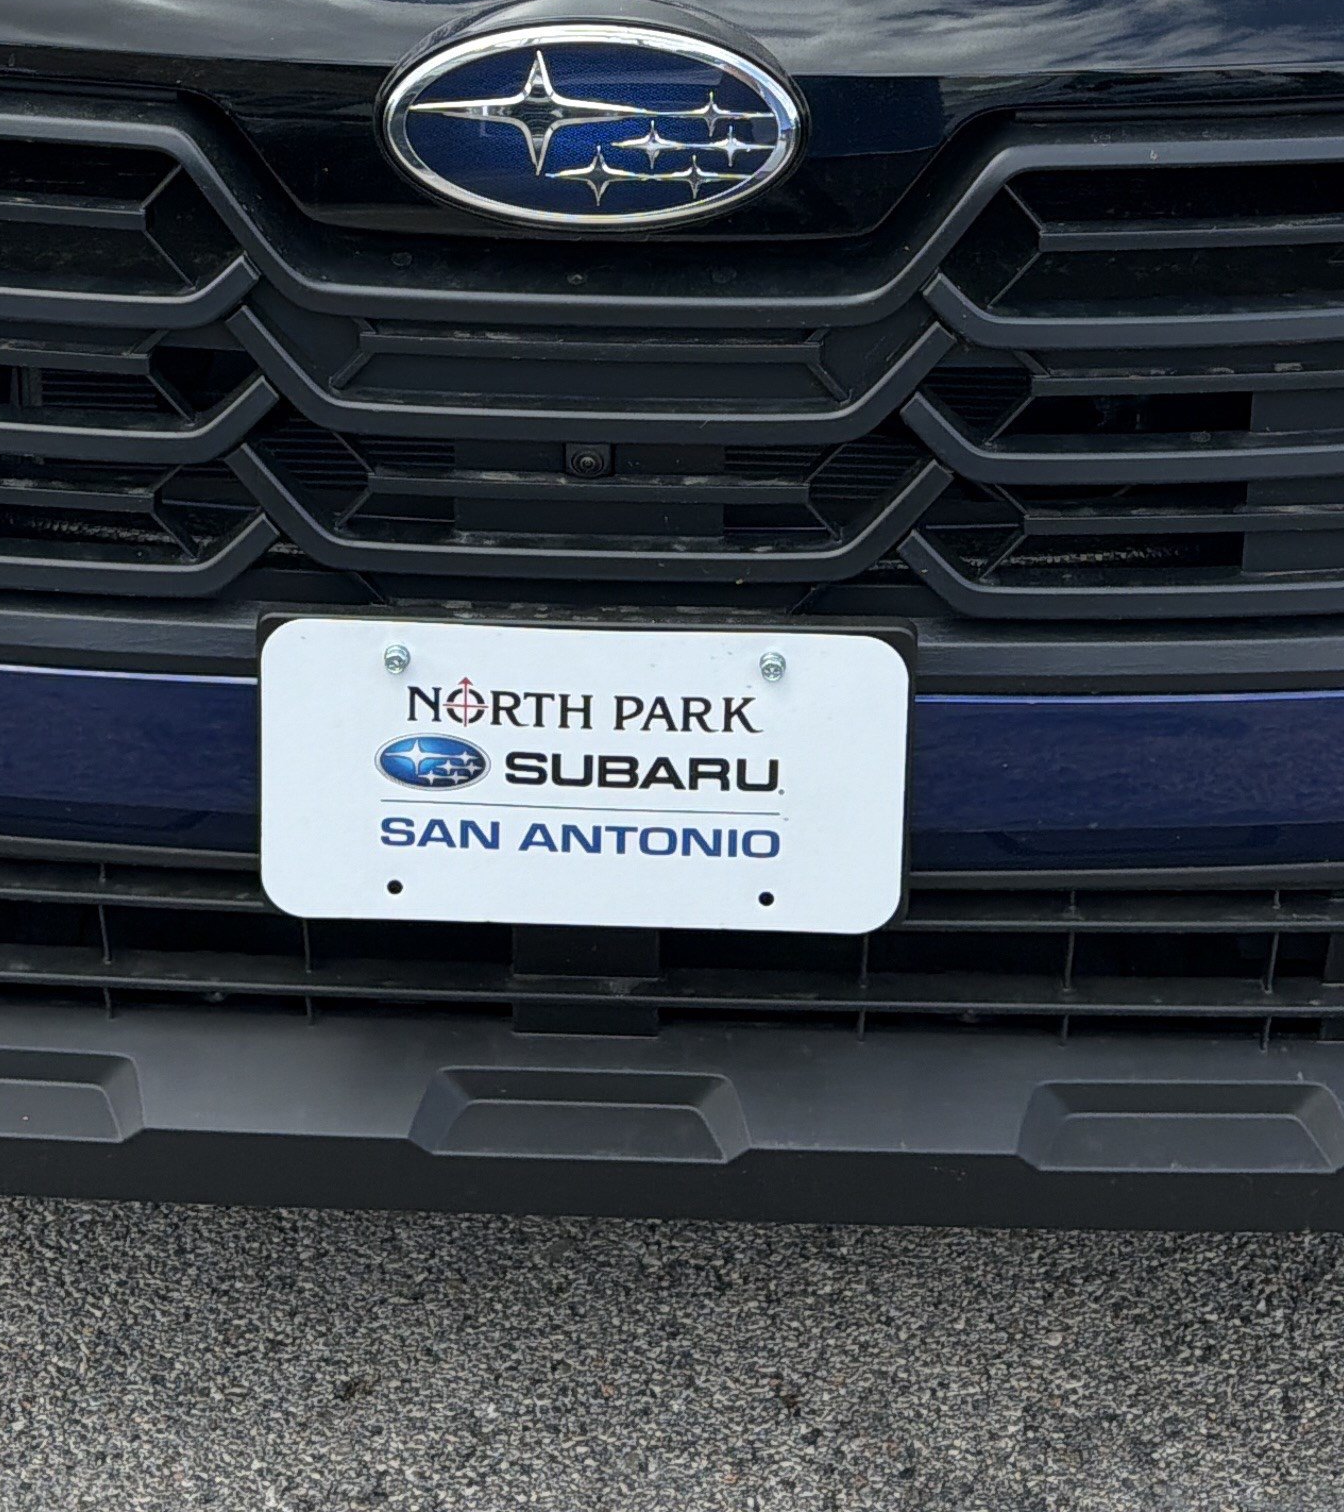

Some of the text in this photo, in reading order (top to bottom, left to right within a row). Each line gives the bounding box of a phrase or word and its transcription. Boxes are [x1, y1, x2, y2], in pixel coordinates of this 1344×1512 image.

[407, 684, 764, 734] NORTH PARK
[504, 751, 780, 793] SUBARU
[379, 816, 782, 860] SAN ANTONIO
